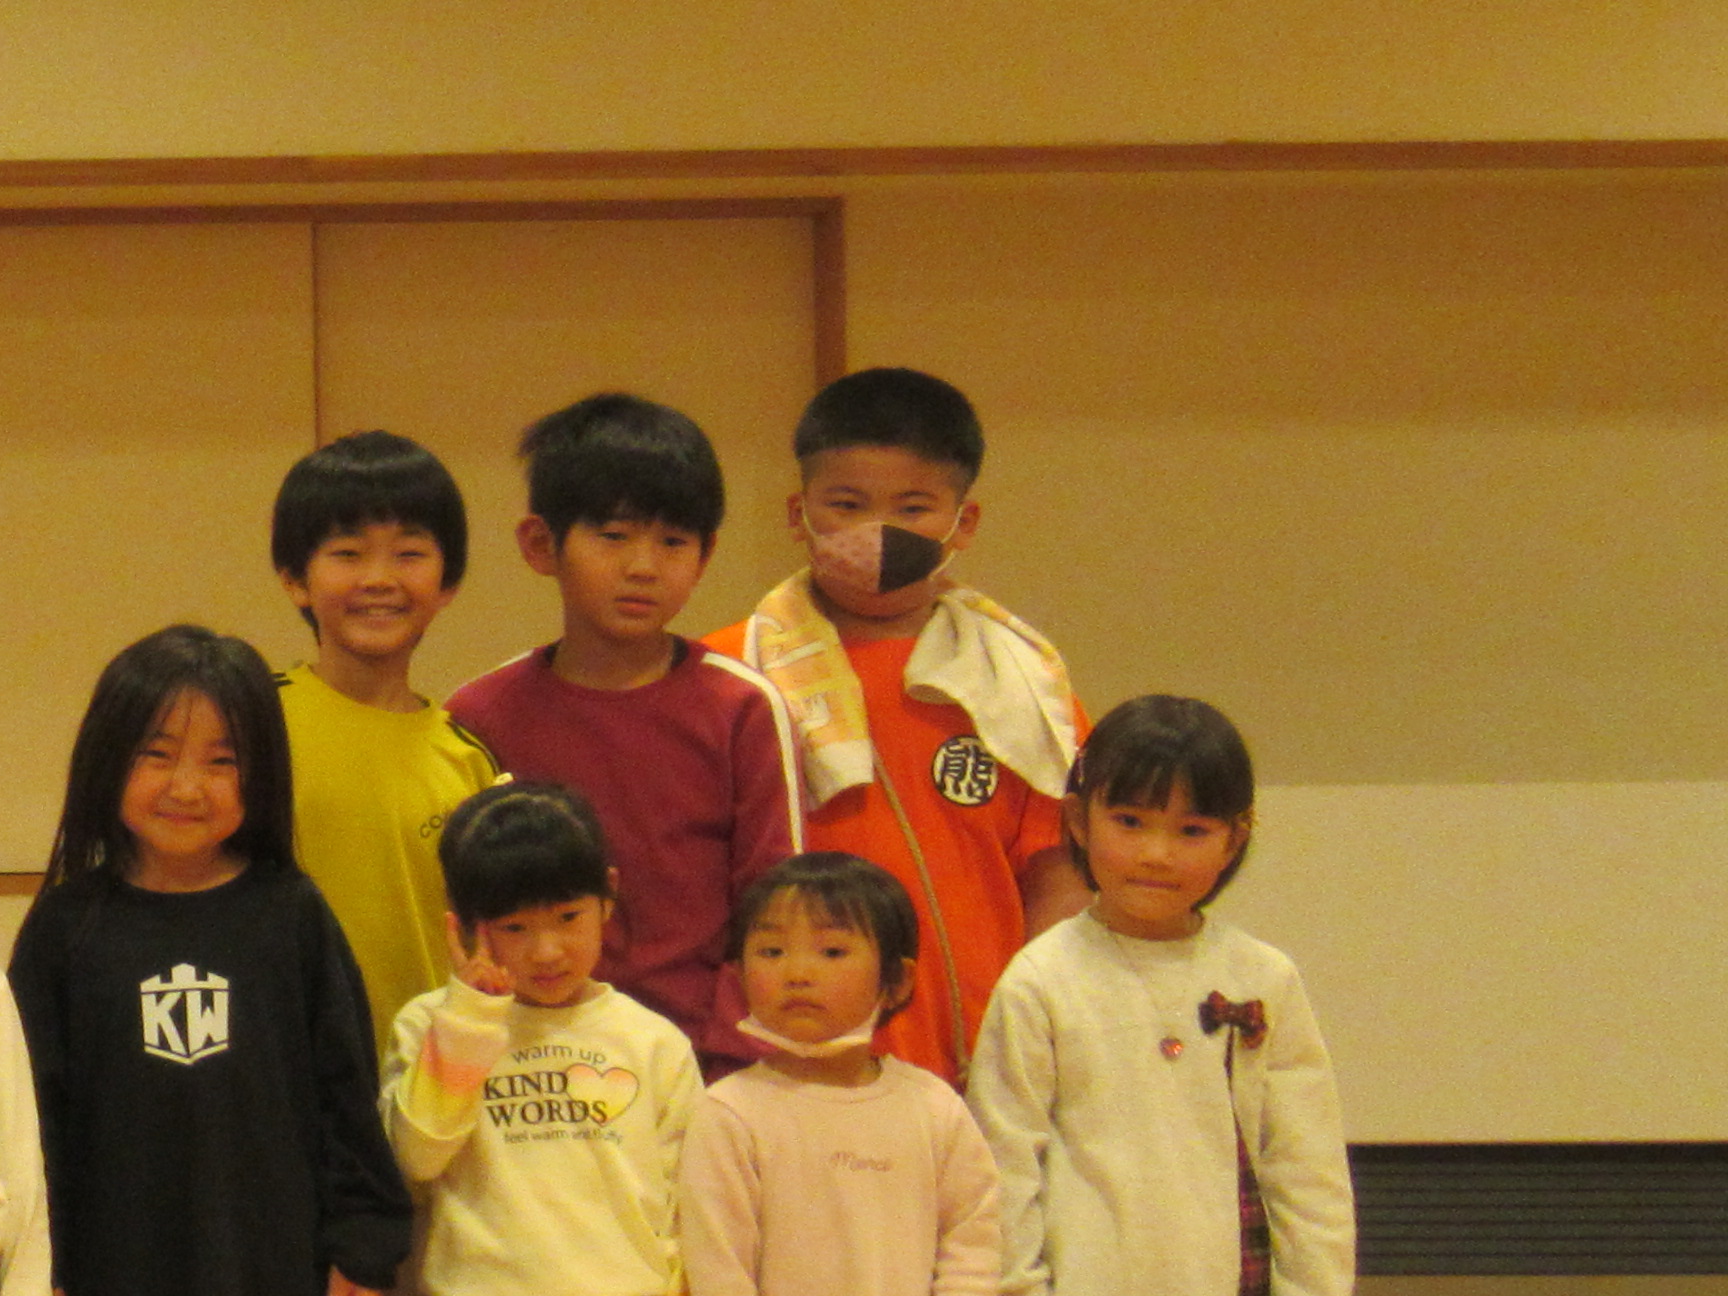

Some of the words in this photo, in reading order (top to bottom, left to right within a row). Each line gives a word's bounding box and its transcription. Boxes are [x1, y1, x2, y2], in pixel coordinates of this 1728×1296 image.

[141, 990, 230, 1055] KW
[510, 1044, 573, 1065] warm
[579, 1047, 607, 1066] up
[483, 1071, 569, 1101] KIND
[486, 1099, 608, 1128] WORDS
